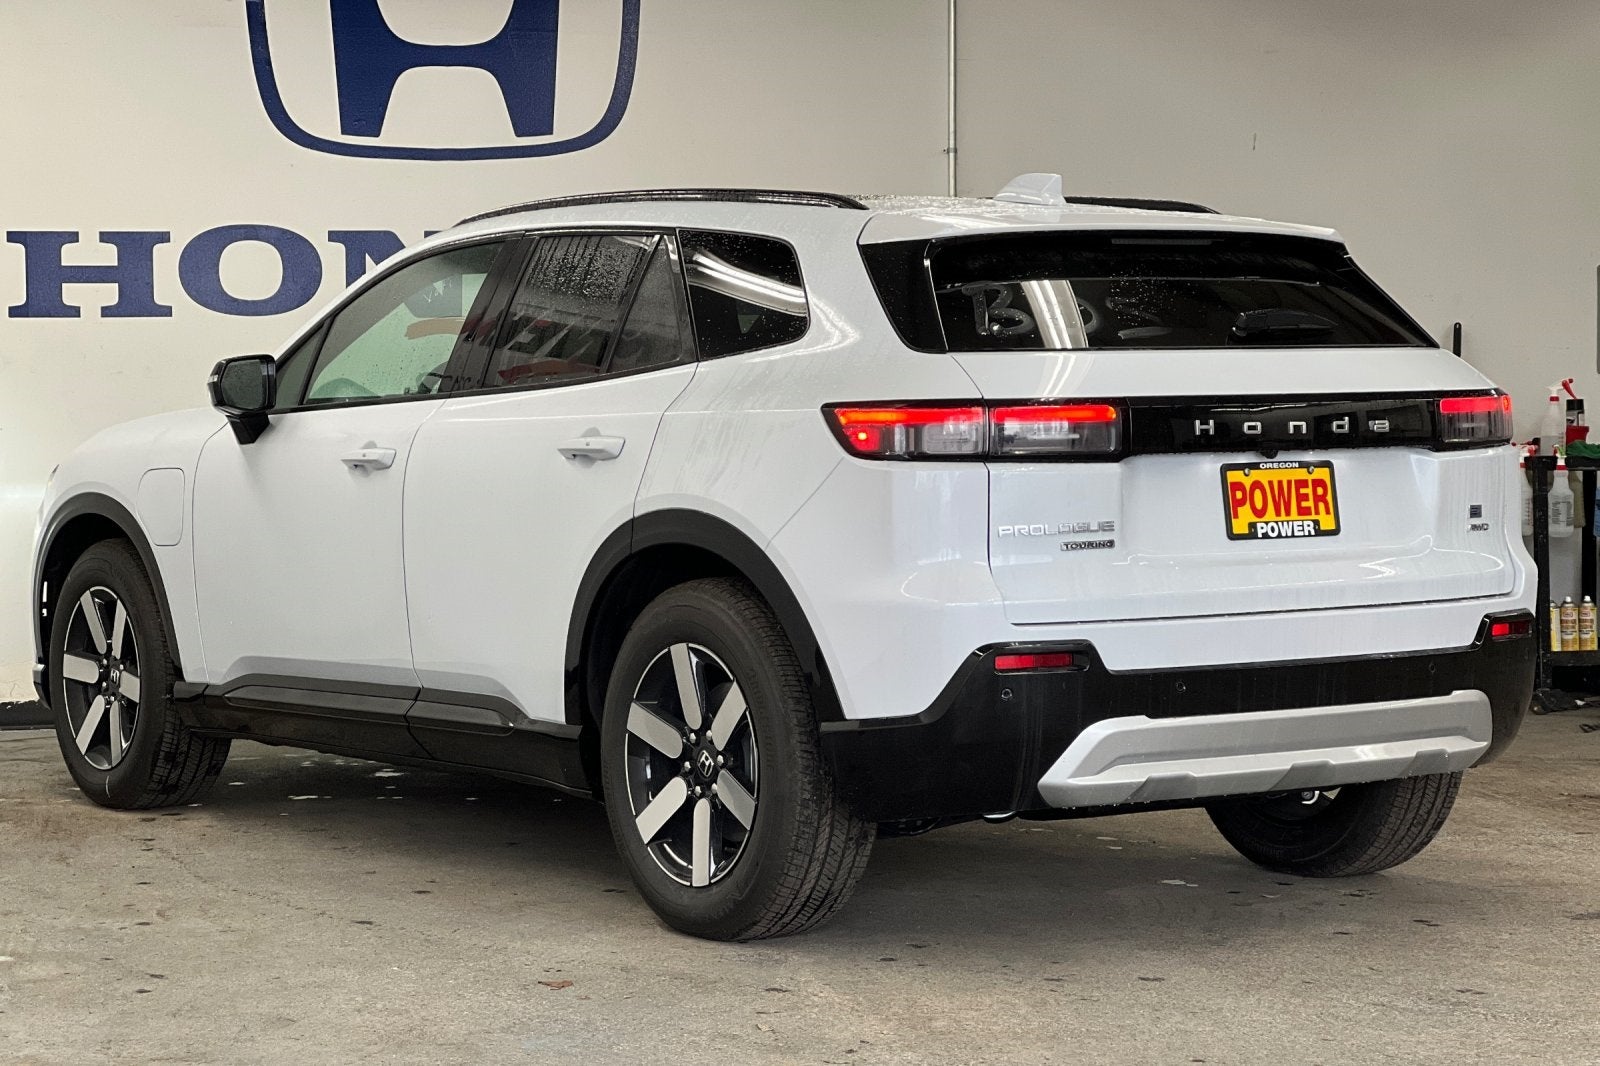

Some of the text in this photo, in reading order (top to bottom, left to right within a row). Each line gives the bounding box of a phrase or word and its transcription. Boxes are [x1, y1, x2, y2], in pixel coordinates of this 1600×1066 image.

[7, 224, 463, 318] HON
[1229, 478, 1331, 519] POWER
[997, 520, 1116, 538] PROLOGUE
[1256, 520, 1316, 538] POWER
[1062, 540, 1115, 551] TOURING
